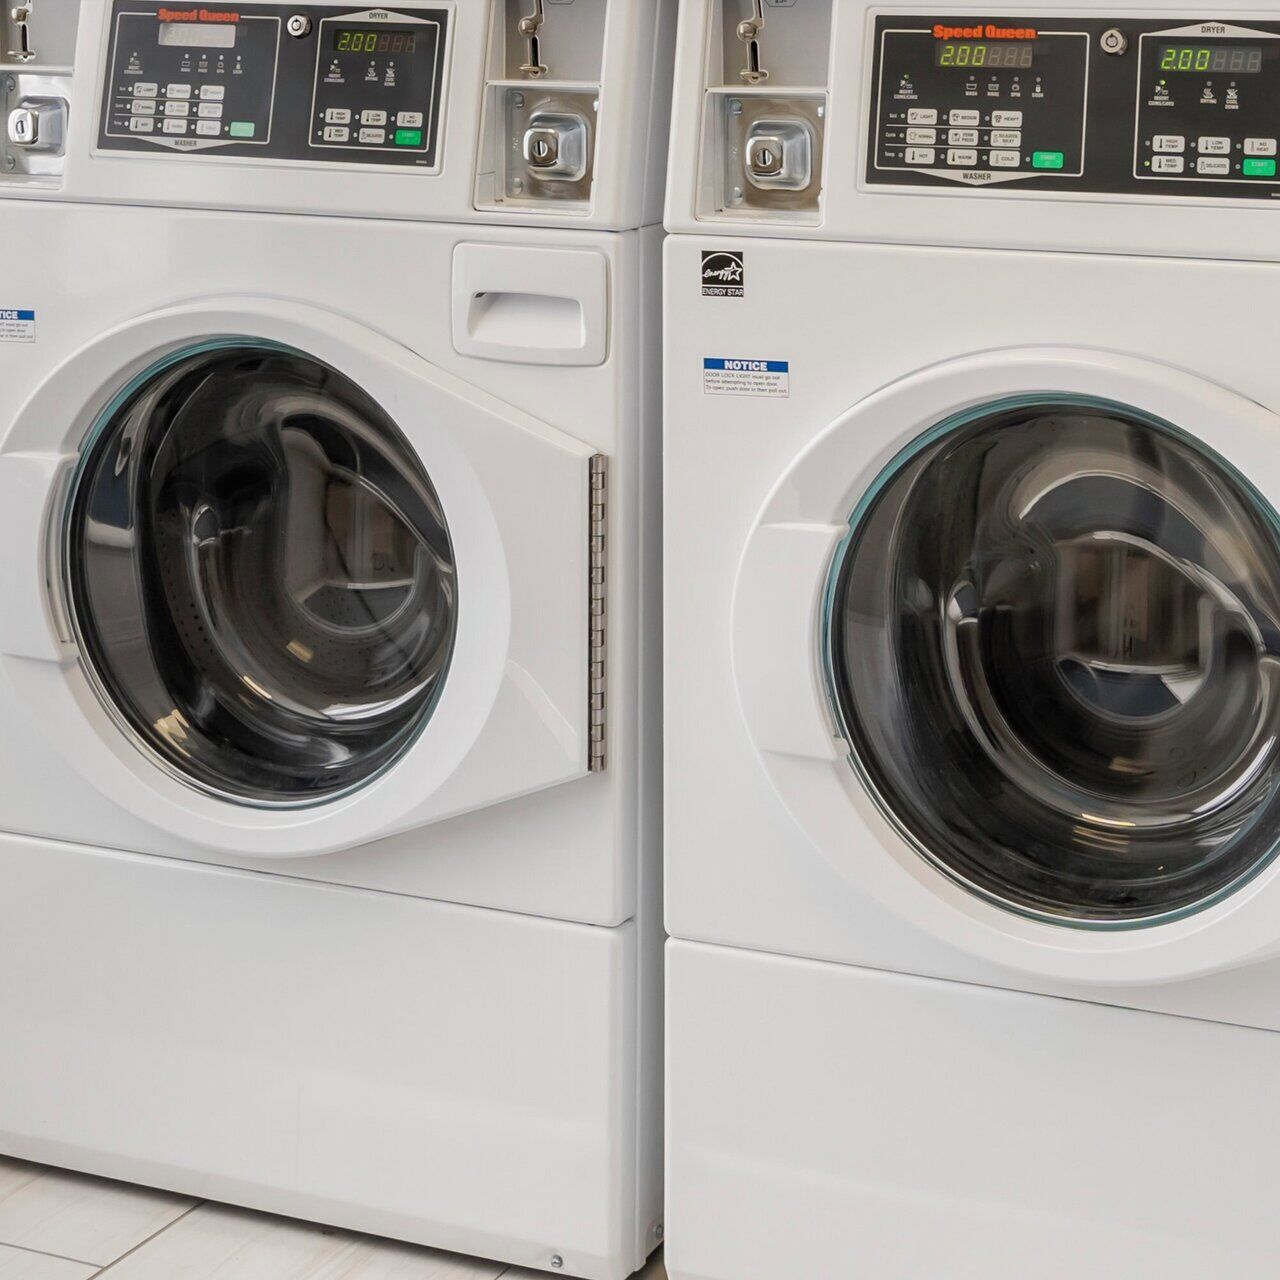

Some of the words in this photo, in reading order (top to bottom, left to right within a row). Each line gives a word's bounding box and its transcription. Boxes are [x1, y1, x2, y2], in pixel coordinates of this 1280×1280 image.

[158, 8, 198, 22] Speed
[199, 9, 240, 22] Queen
[369, 12, 388, 20] DRYER
[933, 25, 983, 40] Speed
[985, 25, 1036, 39] Queen
[1201, 26, 1226, 34] DRYER
[338, 32, 377, 52] 2.00
[940, 45, 986, 66] 2.00
[1161, 49, 1211, 70] 2.00
[962, 172, 991, 181] WASHER
[702, 288, 726, 296] ENERGY
[727, 288, 744, 296] STAR
[724, 360, 768, 371] NOTICE
